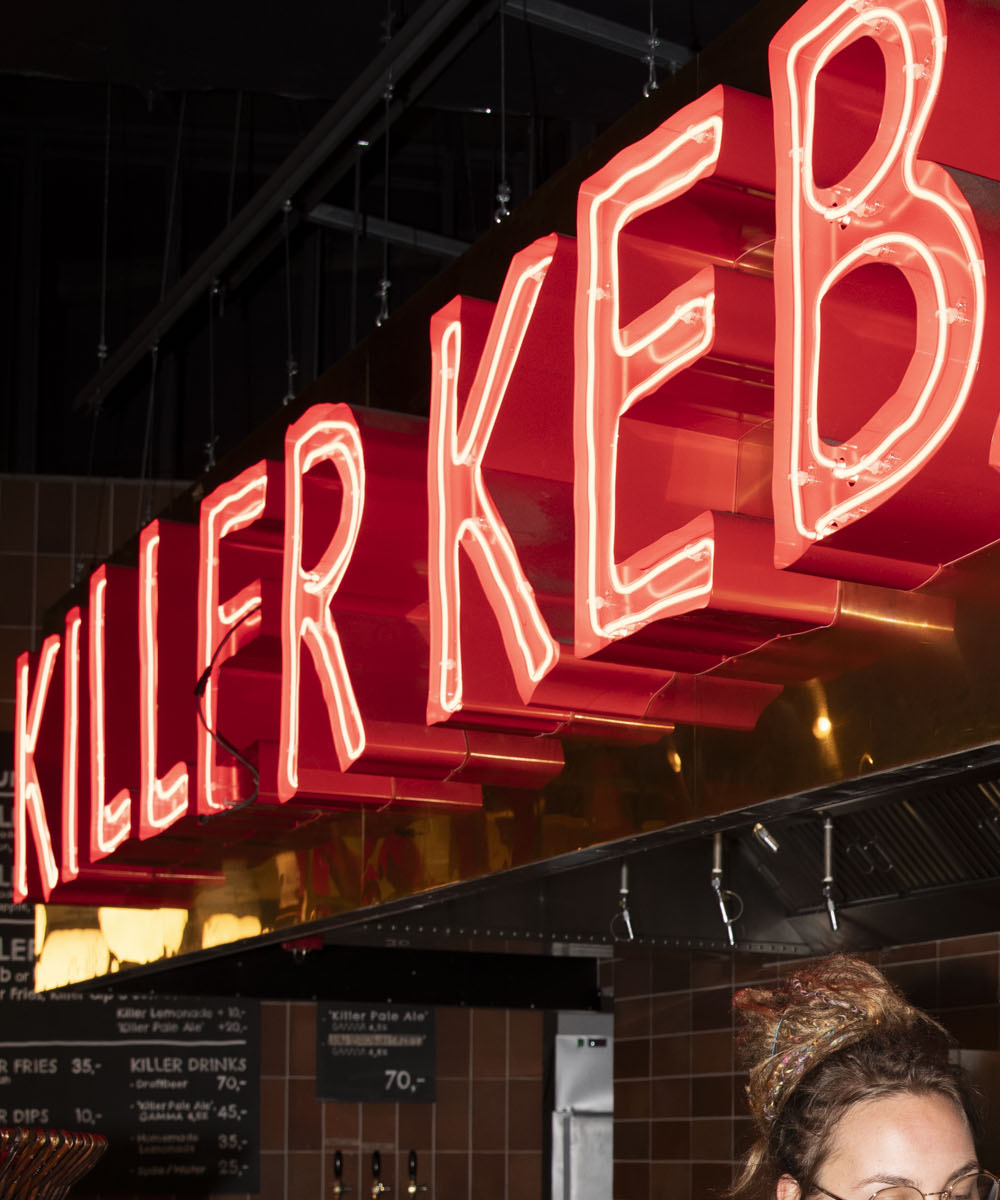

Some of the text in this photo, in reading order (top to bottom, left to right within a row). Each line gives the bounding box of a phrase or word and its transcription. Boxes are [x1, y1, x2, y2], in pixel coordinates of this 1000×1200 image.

[12, 402, 366, 904] KILLER
[116, 1007, 147, 1019] Killer
[150, 1007, 213, 1019] Lemonade
[370, 1010, 400, 1022] Pale
[14, 1058, 58, 1074] FRIES
[130, 1057, 248, 1073] KILLER DRINKS
[13, 1108, 49, 1124] DIPS
